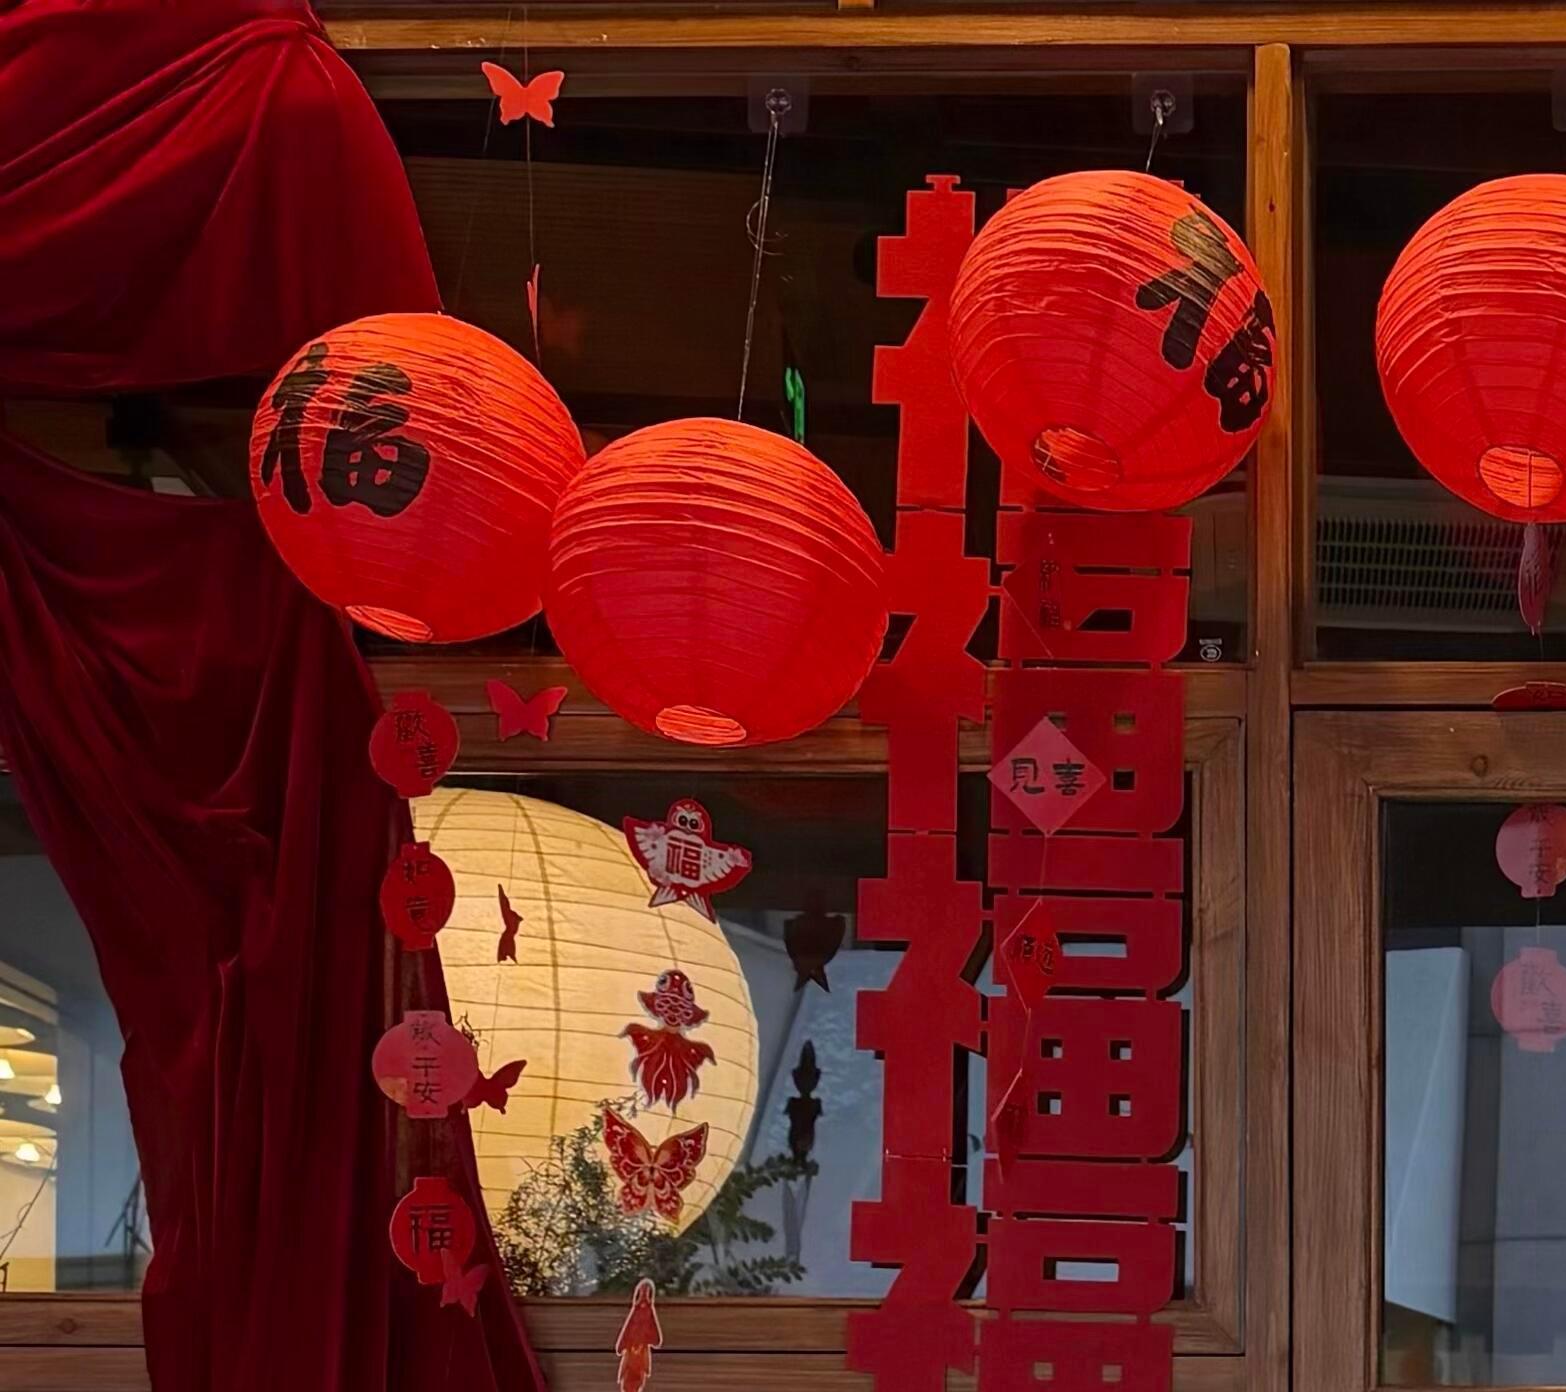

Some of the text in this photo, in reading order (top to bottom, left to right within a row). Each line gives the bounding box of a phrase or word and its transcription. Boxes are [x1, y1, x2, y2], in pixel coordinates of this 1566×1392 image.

[259, 342, 431, 518] 福
[666, 836, 703, 881] 福
[407, 1203, 456, 1255] 福
